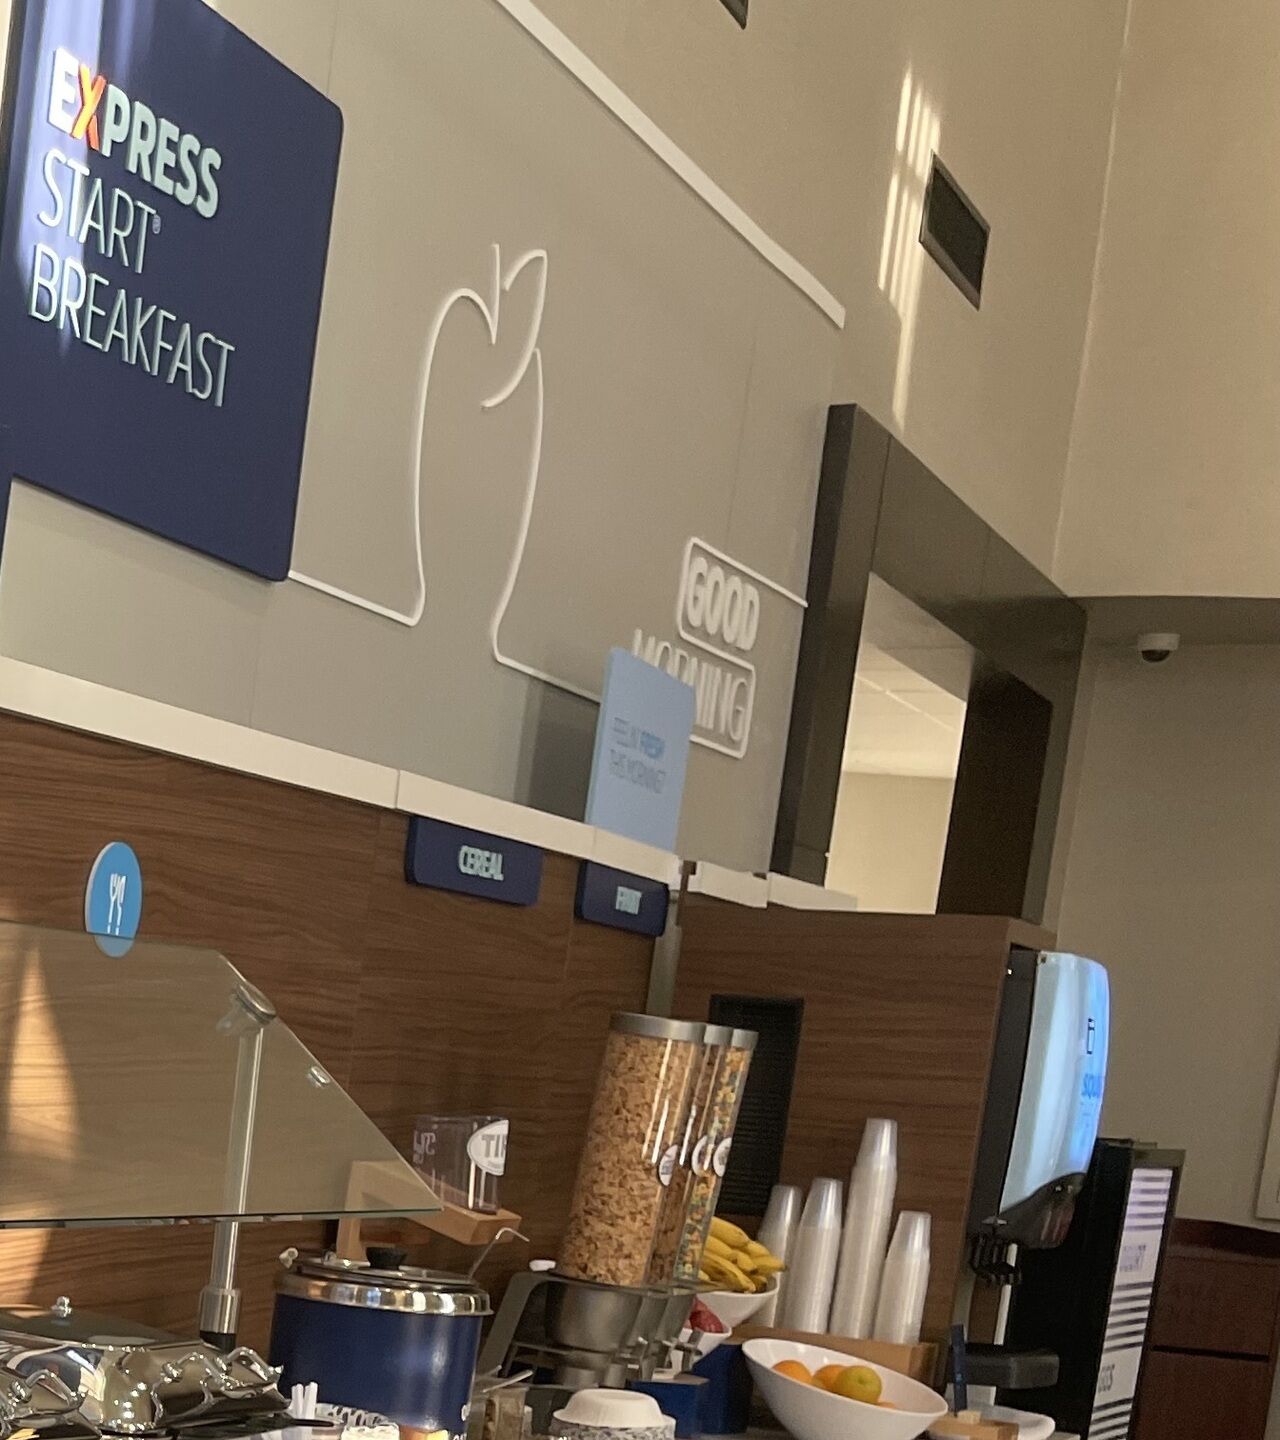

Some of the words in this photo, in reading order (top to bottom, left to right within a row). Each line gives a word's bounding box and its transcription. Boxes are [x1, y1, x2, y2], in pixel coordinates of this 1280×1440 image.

[47, 47, 222, 219] EXPRESS
[28, 243, 235, 407] BREAKFAST
[687, 556, 760, 650] GOOD
